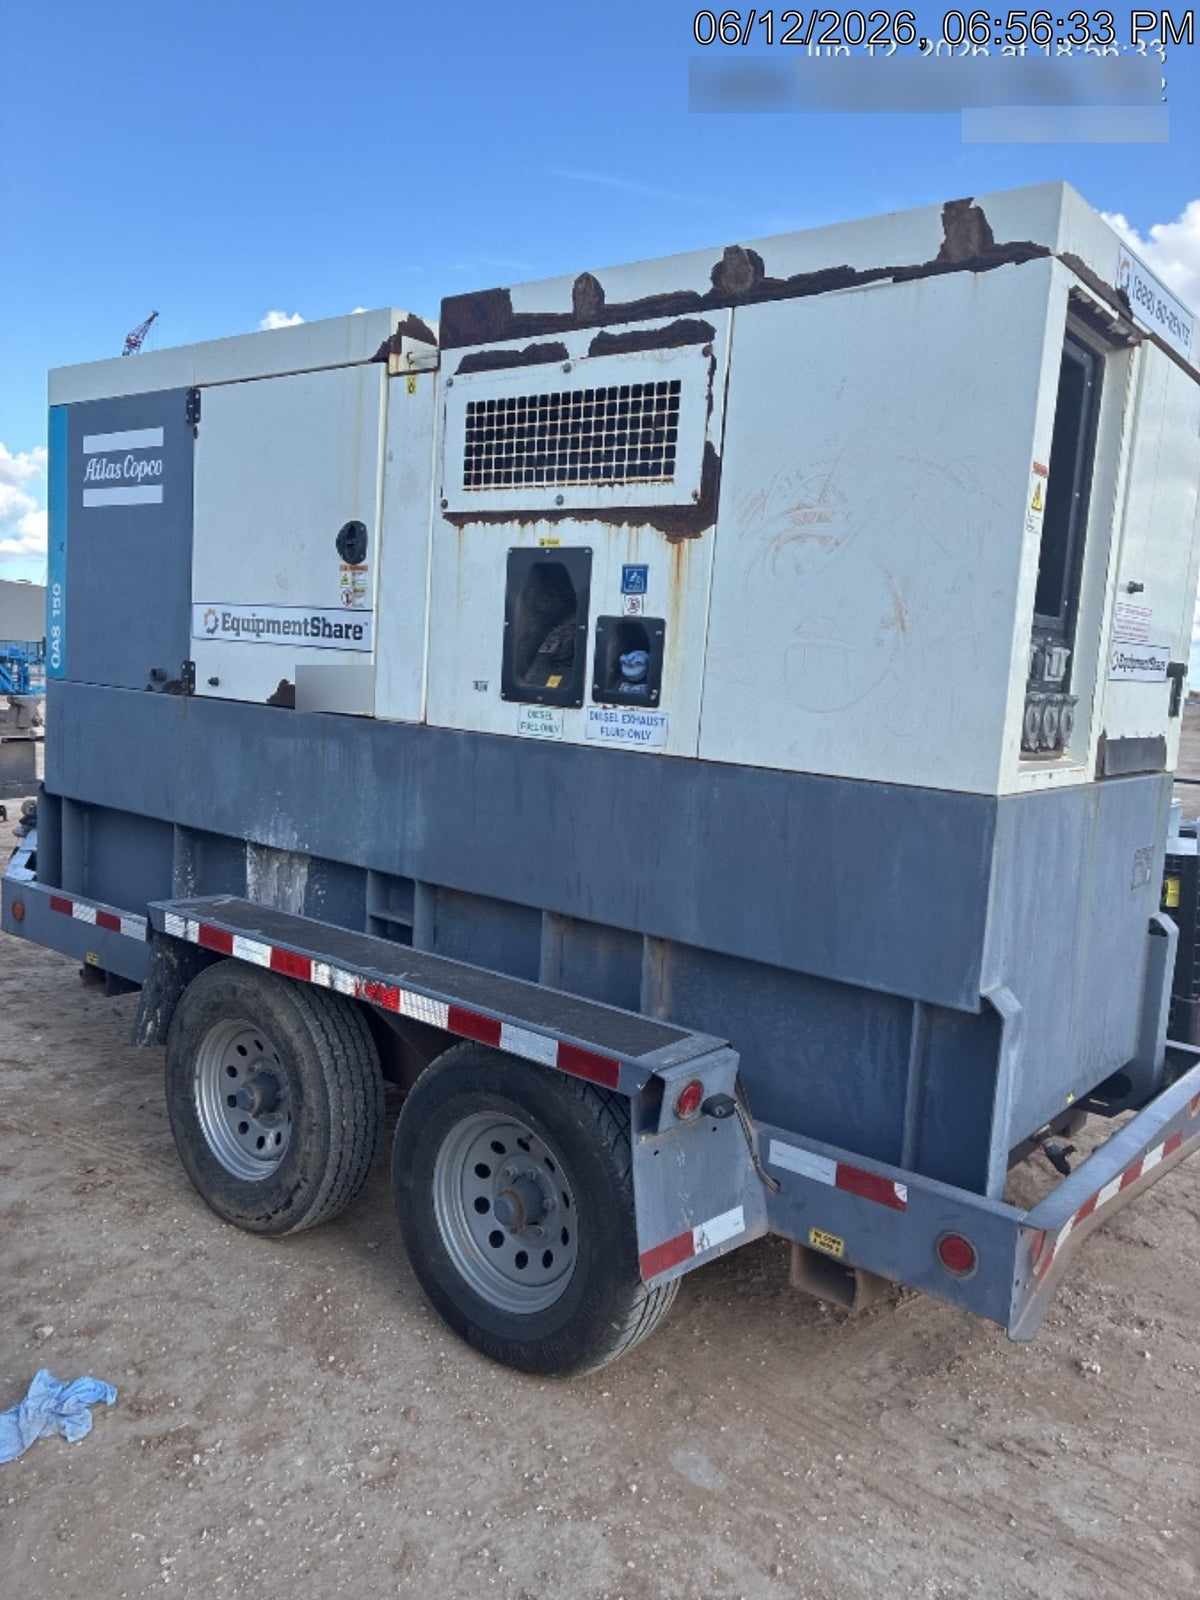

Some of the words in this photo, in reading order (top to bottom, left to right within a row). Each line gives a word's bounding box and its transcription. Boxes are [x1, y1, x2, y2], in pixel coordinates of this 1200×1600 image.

[83, 458, 122, 482] Atlas
[123, 454, 163, 482] Copco
[52, 582, 62, 617] 150
[221, 612, 364, 640] EquipmentShare
[589, 710, 618, 723] DIESEL
[621, 713, 666, 728] EXHAUST
[627, 728, 652, 741] ONLY
